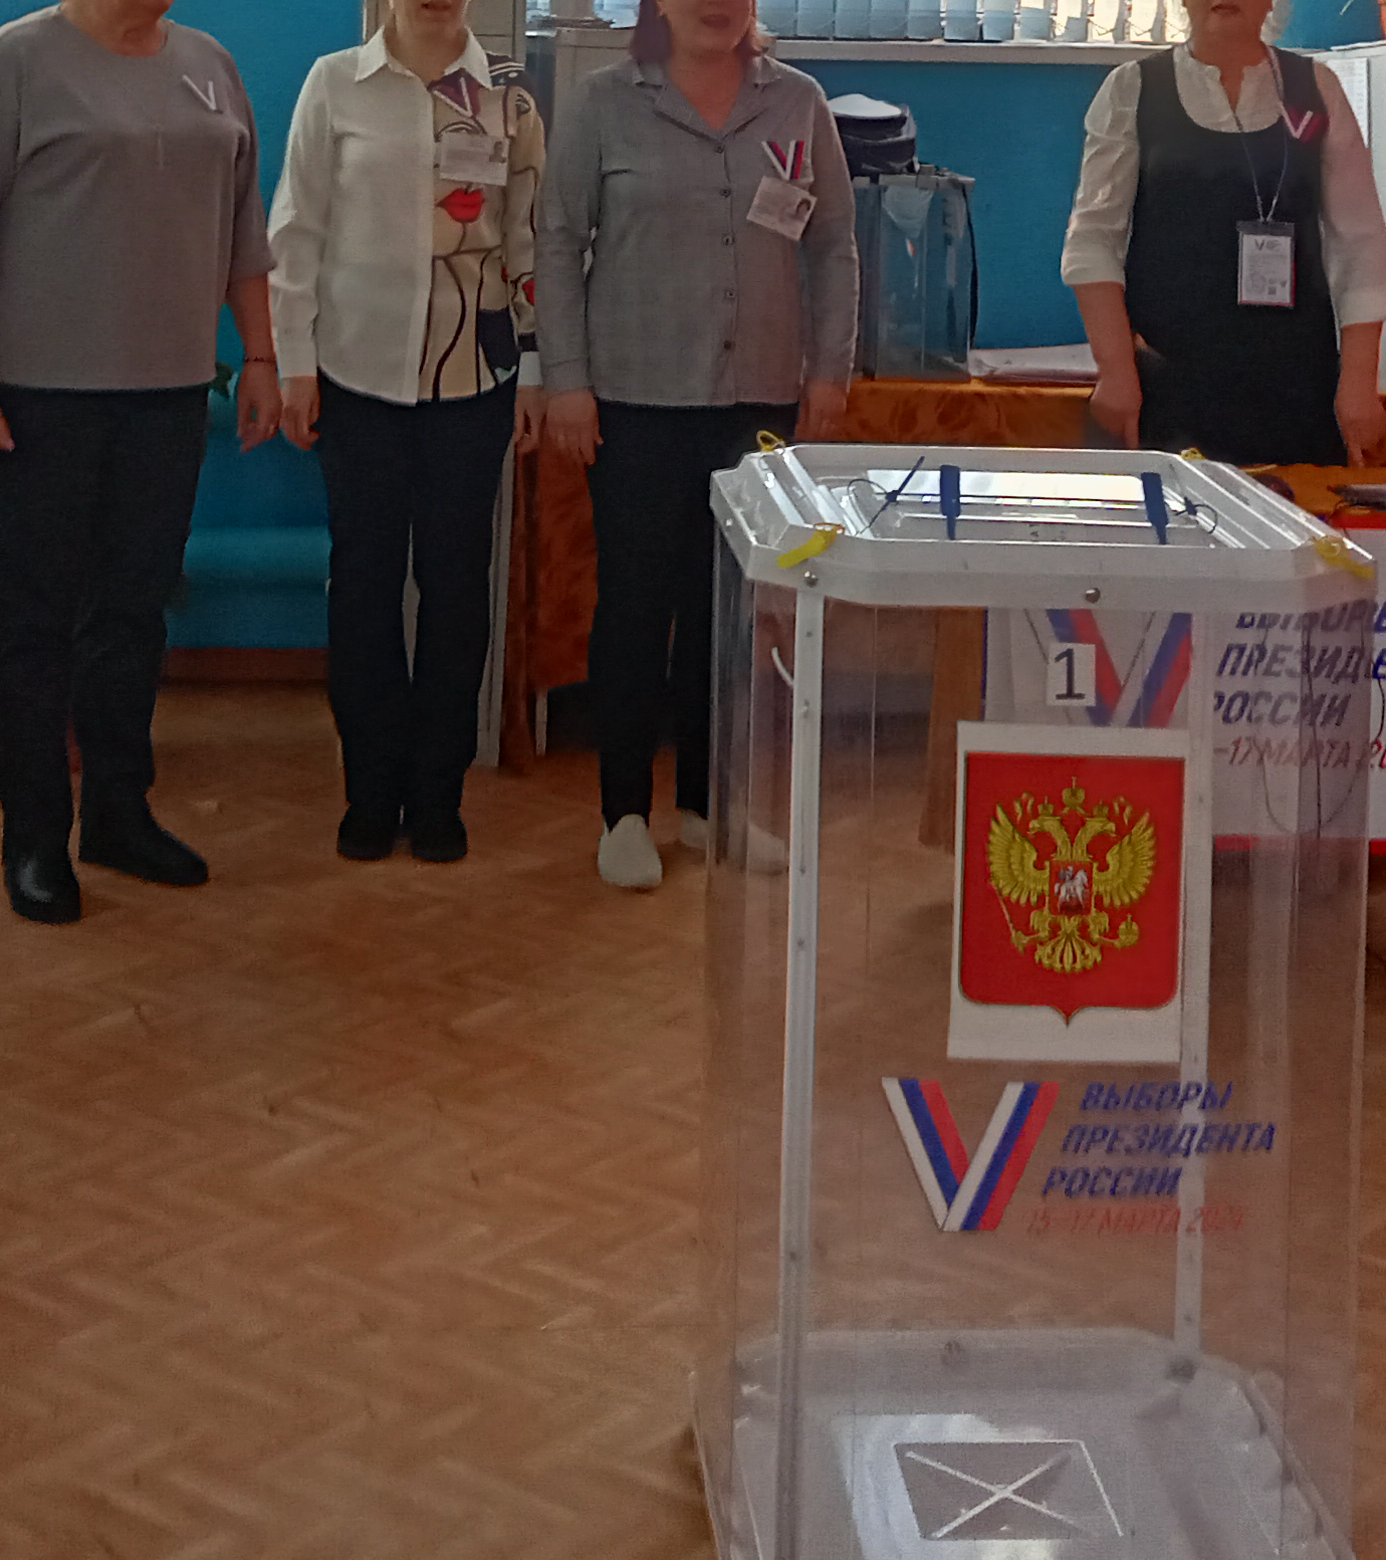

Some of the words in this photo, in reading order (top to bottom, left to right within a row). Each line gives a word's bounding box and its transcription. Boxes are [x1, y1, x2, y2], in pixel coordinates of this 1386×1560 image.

[1054, 647, 1087, 700] 1
[1078, 1080, 1234, 1112] ВЫБОРЫ
[1061, 1122, 1276, 1157] ПРЕЗИДЕНТА
[1042, 1166, 1183, 1199] РОССИИ
